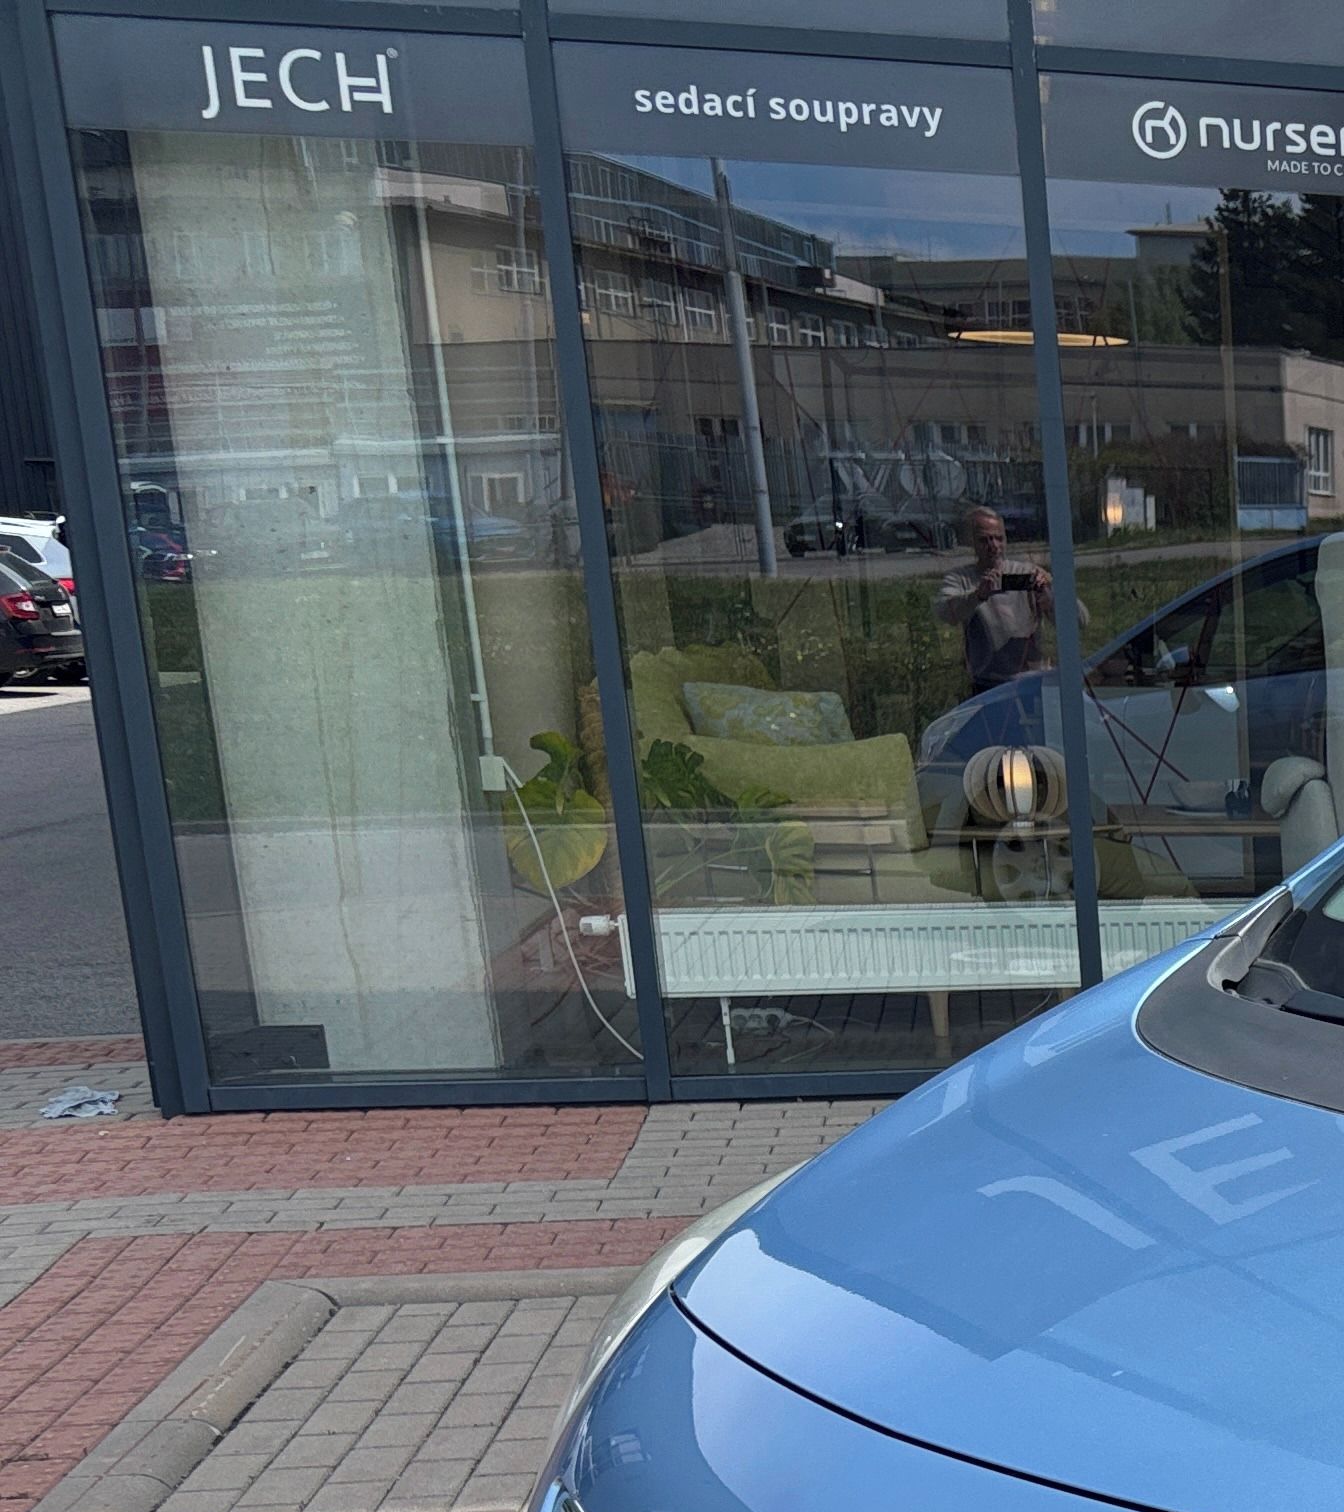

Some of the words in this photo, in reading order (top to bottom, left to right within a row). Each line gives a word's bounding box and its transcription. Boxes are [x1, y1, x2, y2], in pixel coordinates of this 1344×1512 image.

[634, 84, 757, 118] sedací
[769, 97, 943, 138] soupravy
[1267, 160, 1309, 174] MADE
[1312, 162, 1331, 175] TO
